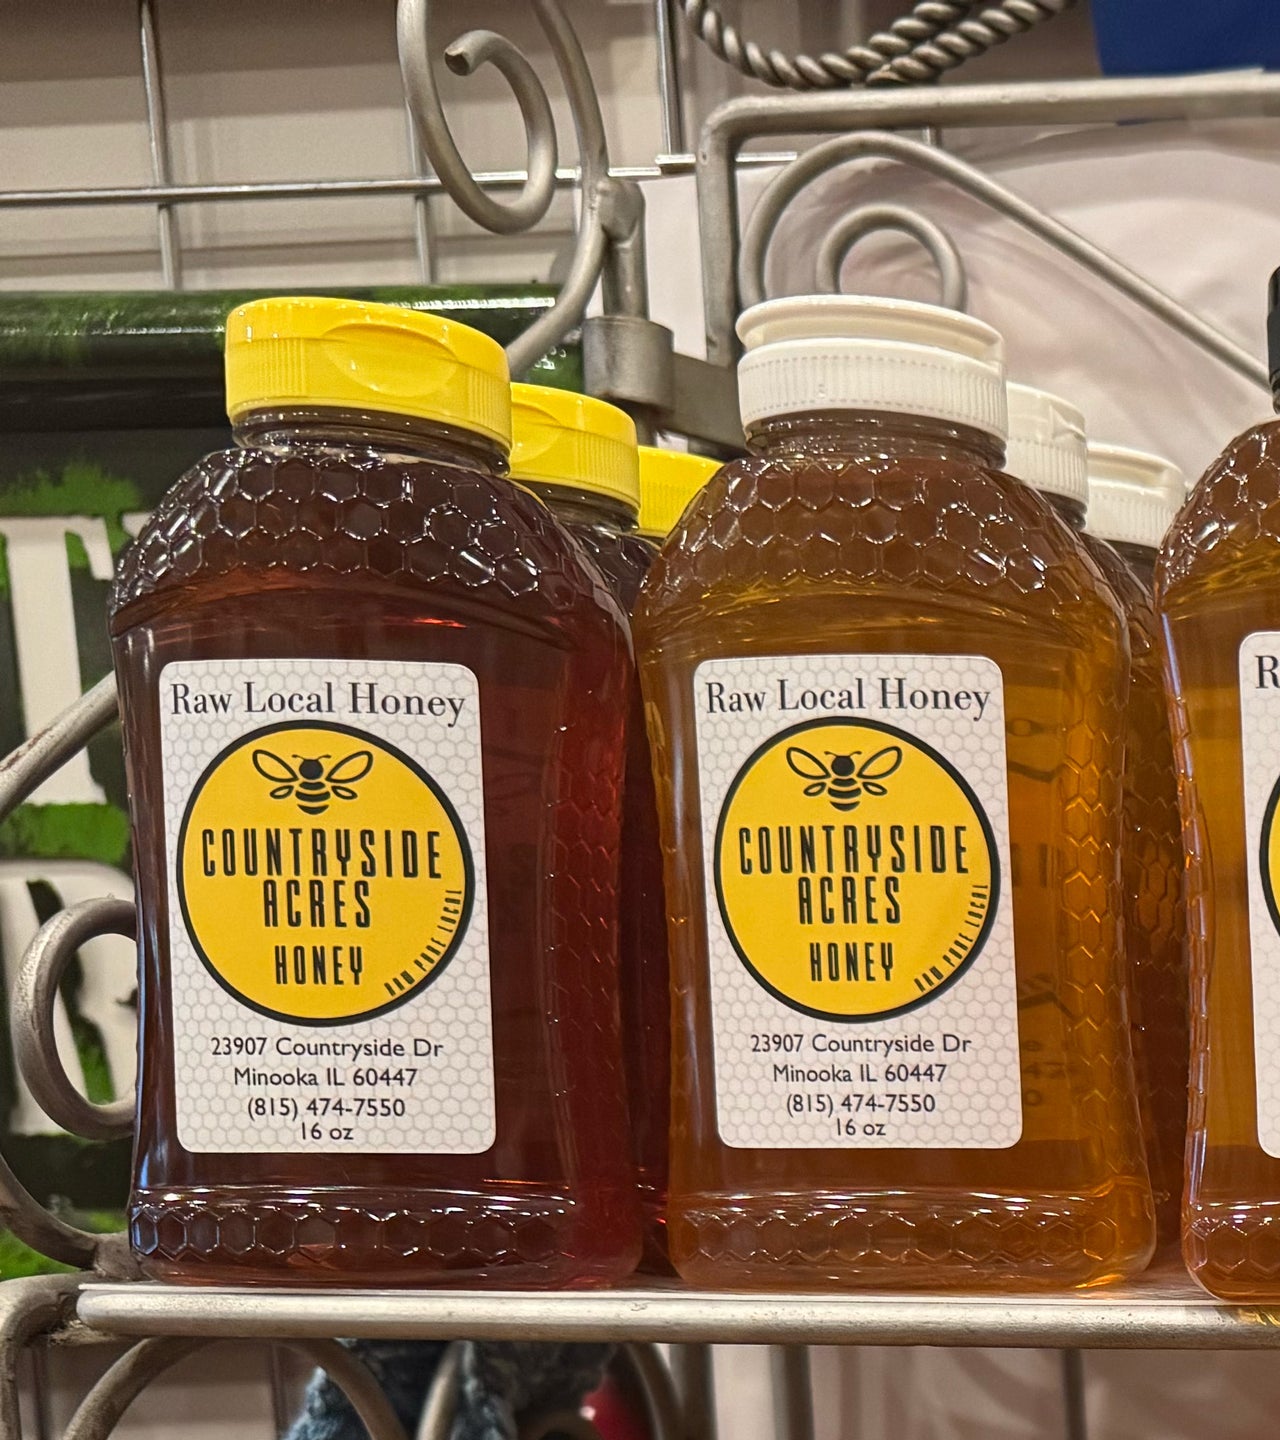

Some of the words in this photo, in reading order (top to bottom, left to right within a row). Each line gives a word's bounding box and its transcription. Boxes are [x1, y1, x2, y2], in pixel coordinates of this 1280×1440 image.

[171, 683, 232, 716] Raw
[243, 682, 335, 714] Local
[347, 682, 466, 728] Honey
[705, 682, 767, 715] Raw
[777, 678, 867, 711] Local
[878, 677, 990, 721] Honey
[202, 828, 442, 879] COUNTRYSIDE
[739, 825, 969, 875] COUNTRYSIDE
[263, 880, 371, 929] ACRES
[437, 889, 462, 933] LOCAL
[798, 876, 901, 925] ACRES
[965, 885, 988, 928] LOCAL
[275, 945, 364, 986] HONEY
[809, 942, 894, 983] HONEY
[211, 1037, 268, 1057] 23907
[276, 1037, 406, 1063] Countryside
[414, 1040, 444, 1058] Dr
[751, 1034, 804, 1053] 23907
[812, 1033, 935, 1059] Countryside
[942, 1035, 973, 1053] Dr
[234, 1067, 319, 1088] Minooka
[326, 1067, 345, 1087] IL
[352, 1068, 418, 1088] 60447
[773, 1063, 853, 1083] Minooka
[860, 1064, 878, 1082] IL
[884, 1064, 947, 1083] 60447
[247, 1097, 299, 1122] (815)
[306, 1098, 405, 1118] 474-7550
[786, 1093, 834, 1118] (815)
[841, 1094, 936, 1113] 474-7550
[301, 1124, 324, 1141] 16
[329, 1126, 354, 1141] oz
[836, 1119, 857, 1137] 16
[862, 1122, 886, 1137] oz
